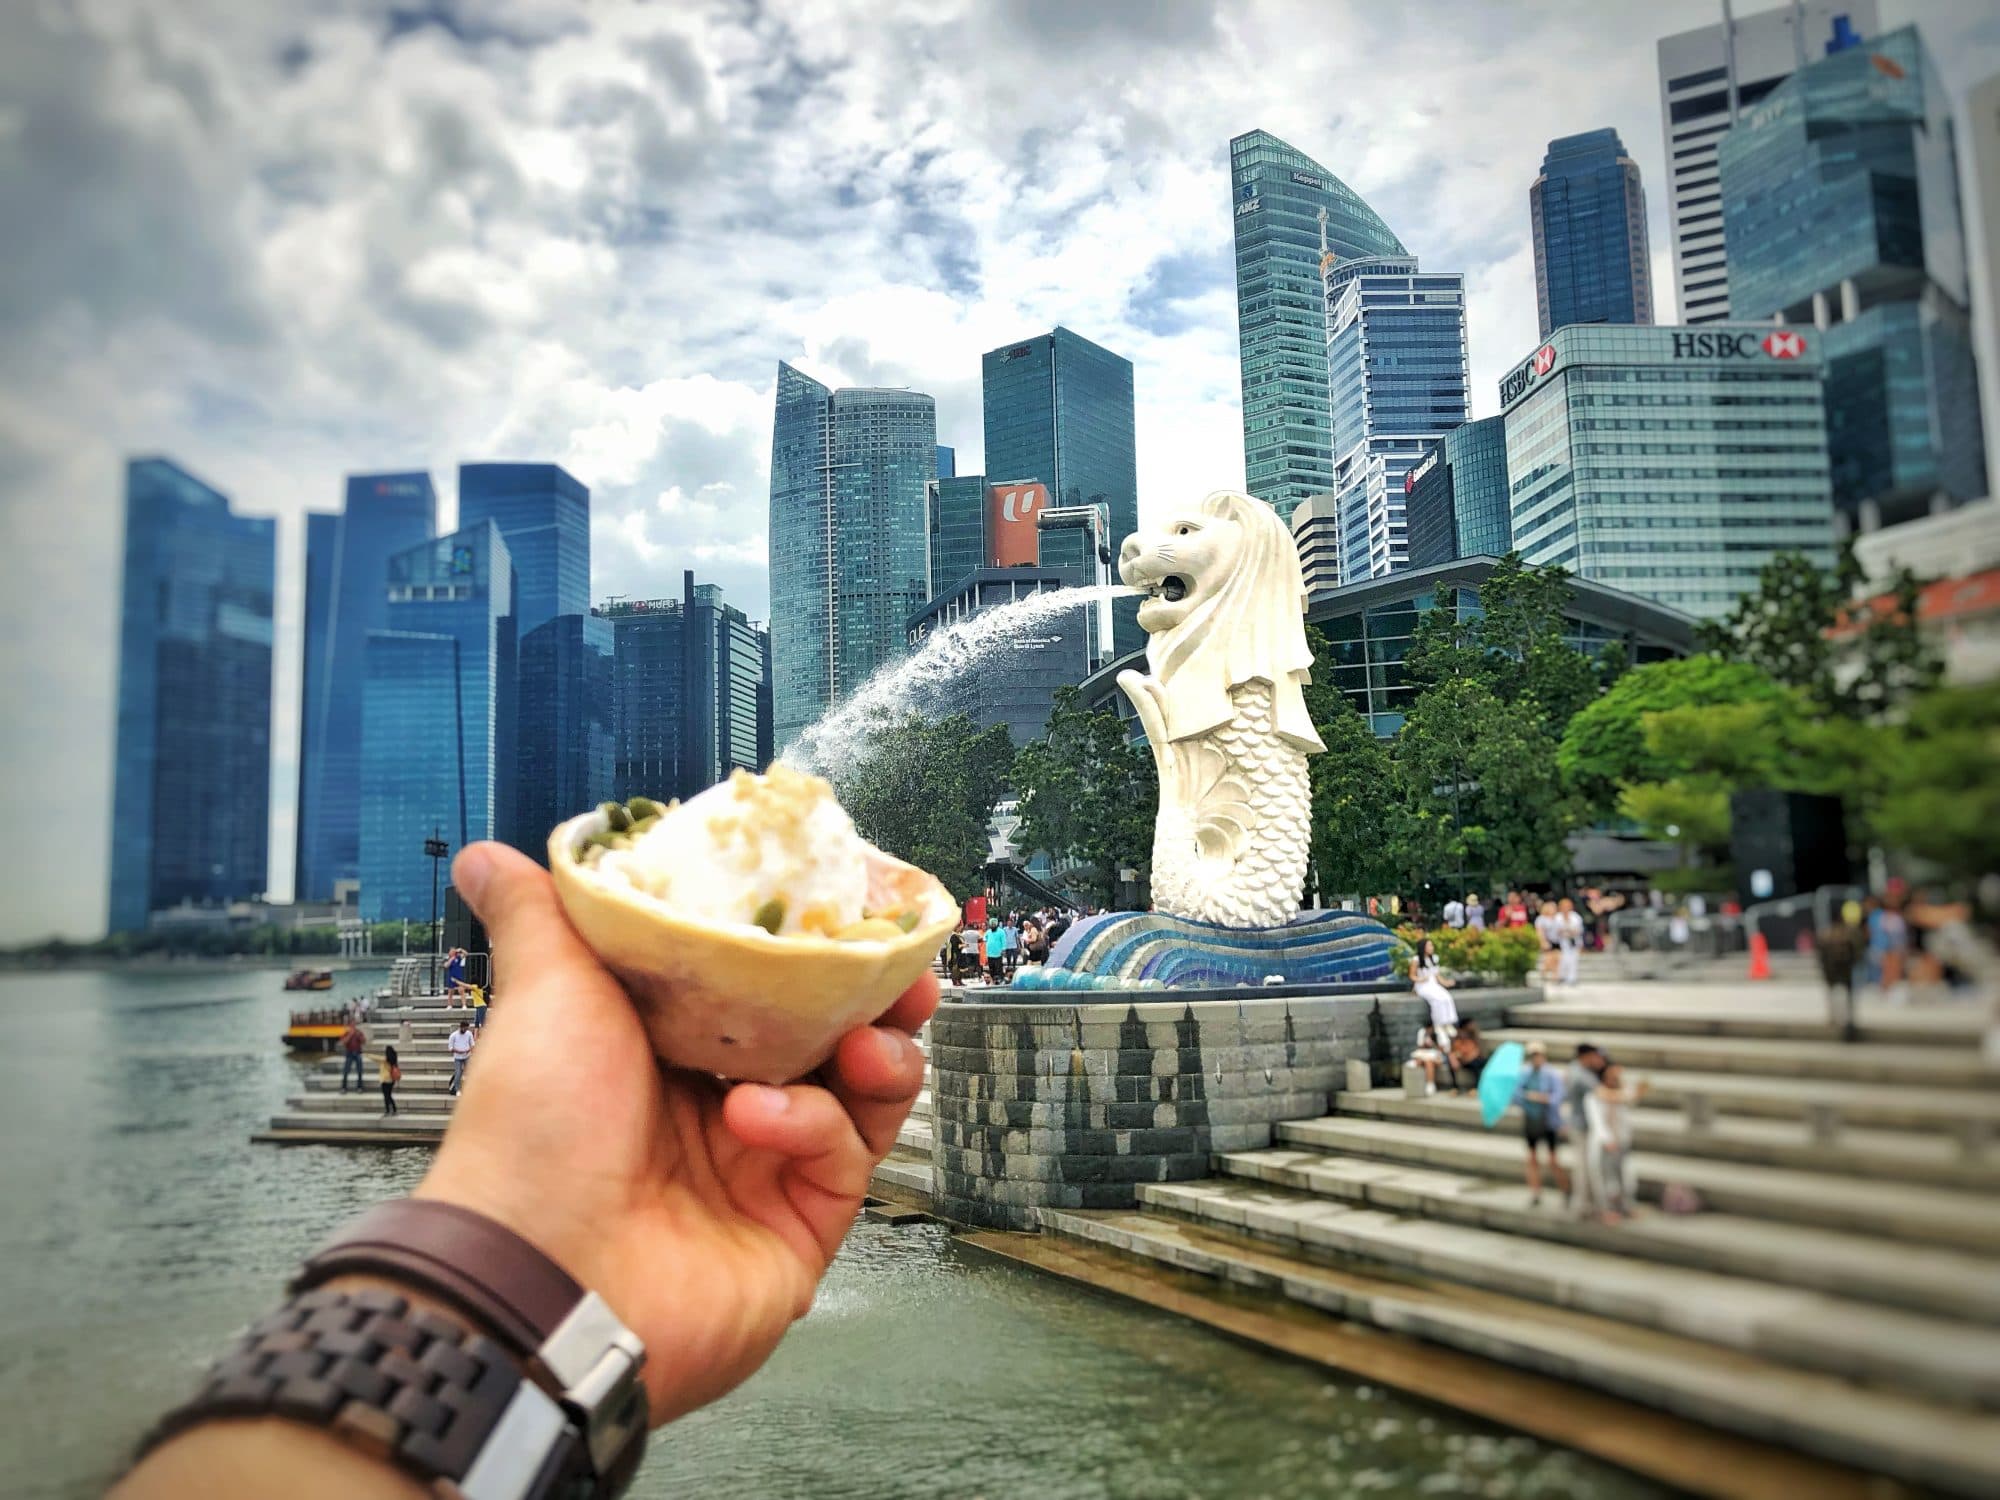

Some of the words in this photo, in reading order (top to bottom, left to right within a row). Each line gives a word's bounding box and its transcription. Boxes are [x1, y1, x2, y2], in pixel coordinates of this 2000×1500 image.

[1293, 172, 1321, 186] Keppel
[1236, 198, 1260, 215] ANZ
[1672, 332, 1757, 360] HSBC
[1499, 359, 1536, 409] HSBC
